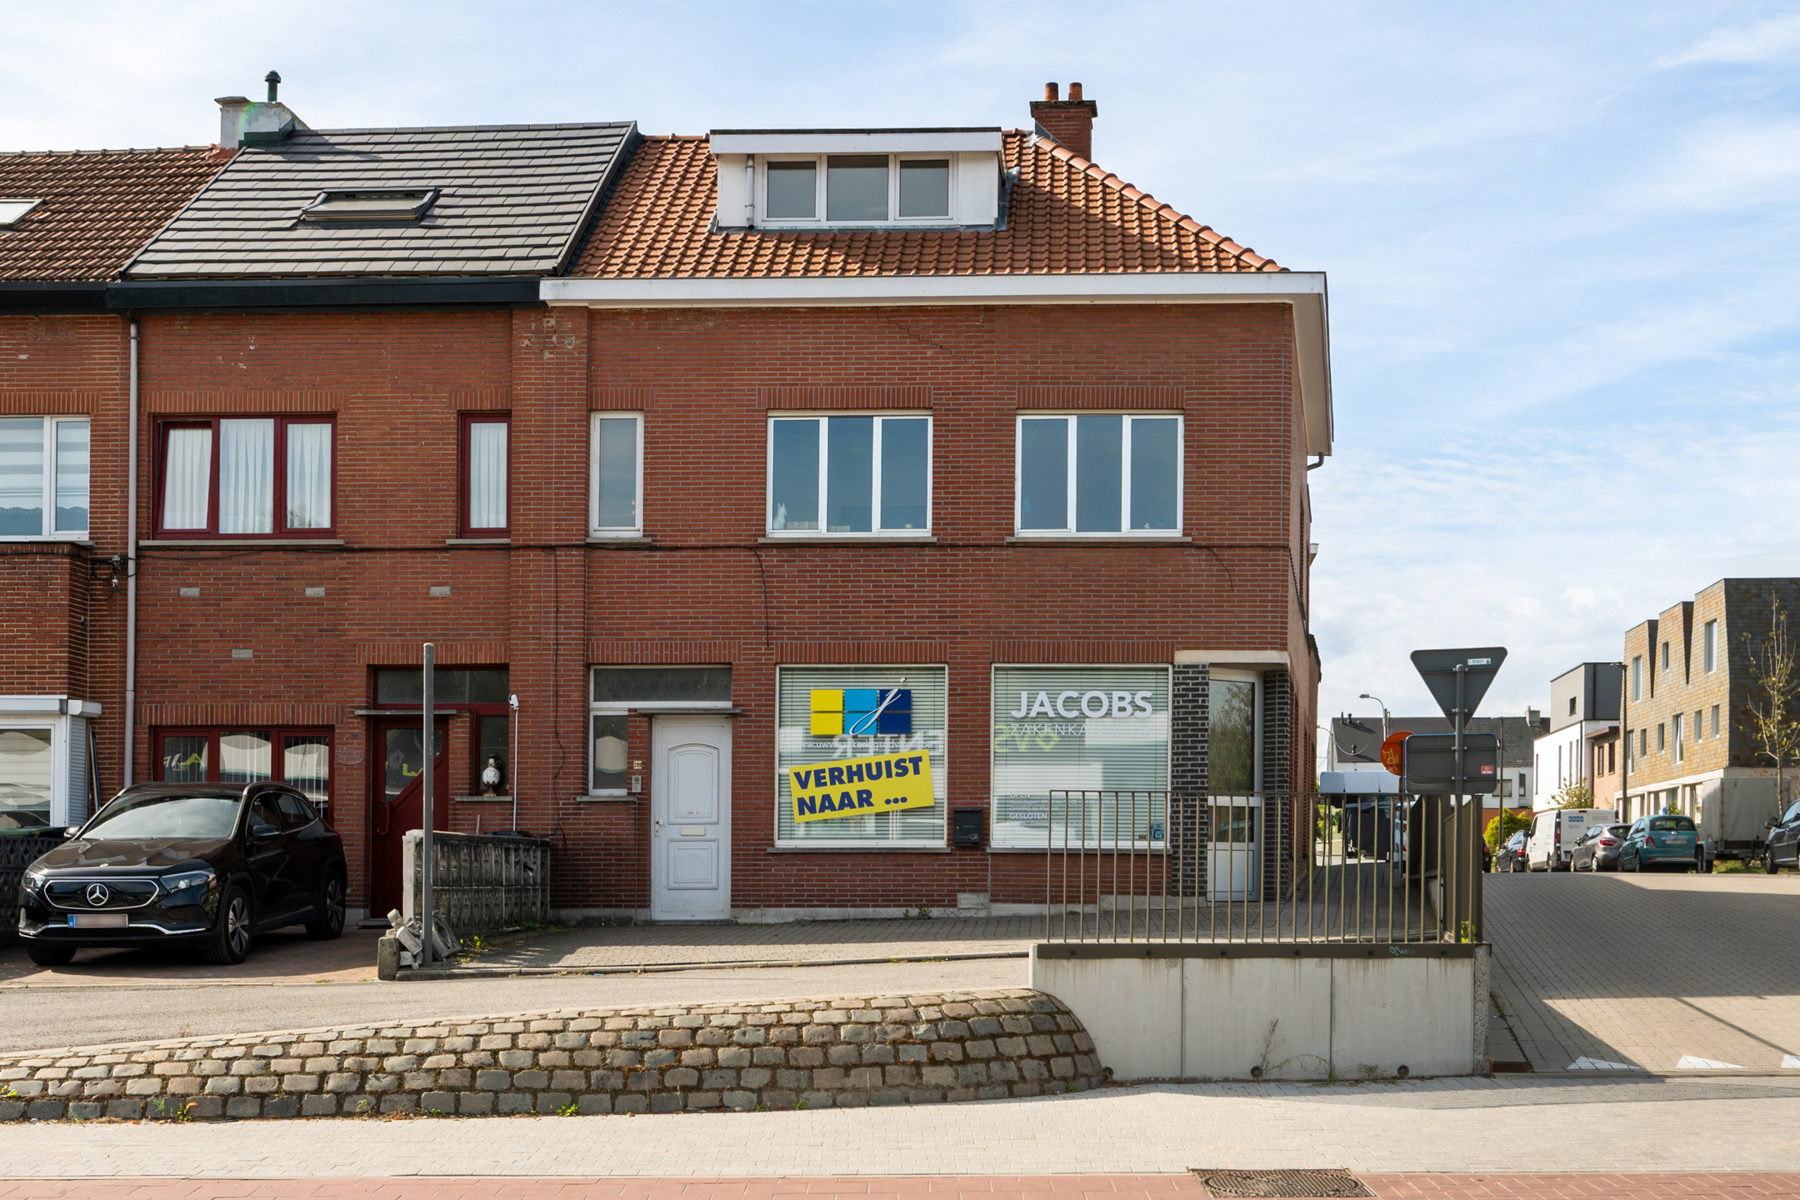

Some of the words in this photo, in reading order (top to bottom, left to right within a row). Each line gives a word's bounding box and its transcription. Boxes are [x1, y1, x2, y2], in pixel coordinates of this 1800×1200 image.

[1010, 690, 1153, 718] JACOBS
[1010, 723, 1151, 736] ZAKENKANTOOR
[793, 755, 923, 790] VERHUIST
[796, 788, 875, 816] NAAR
[1009, 812, 1048, 820] GESLOTEN
